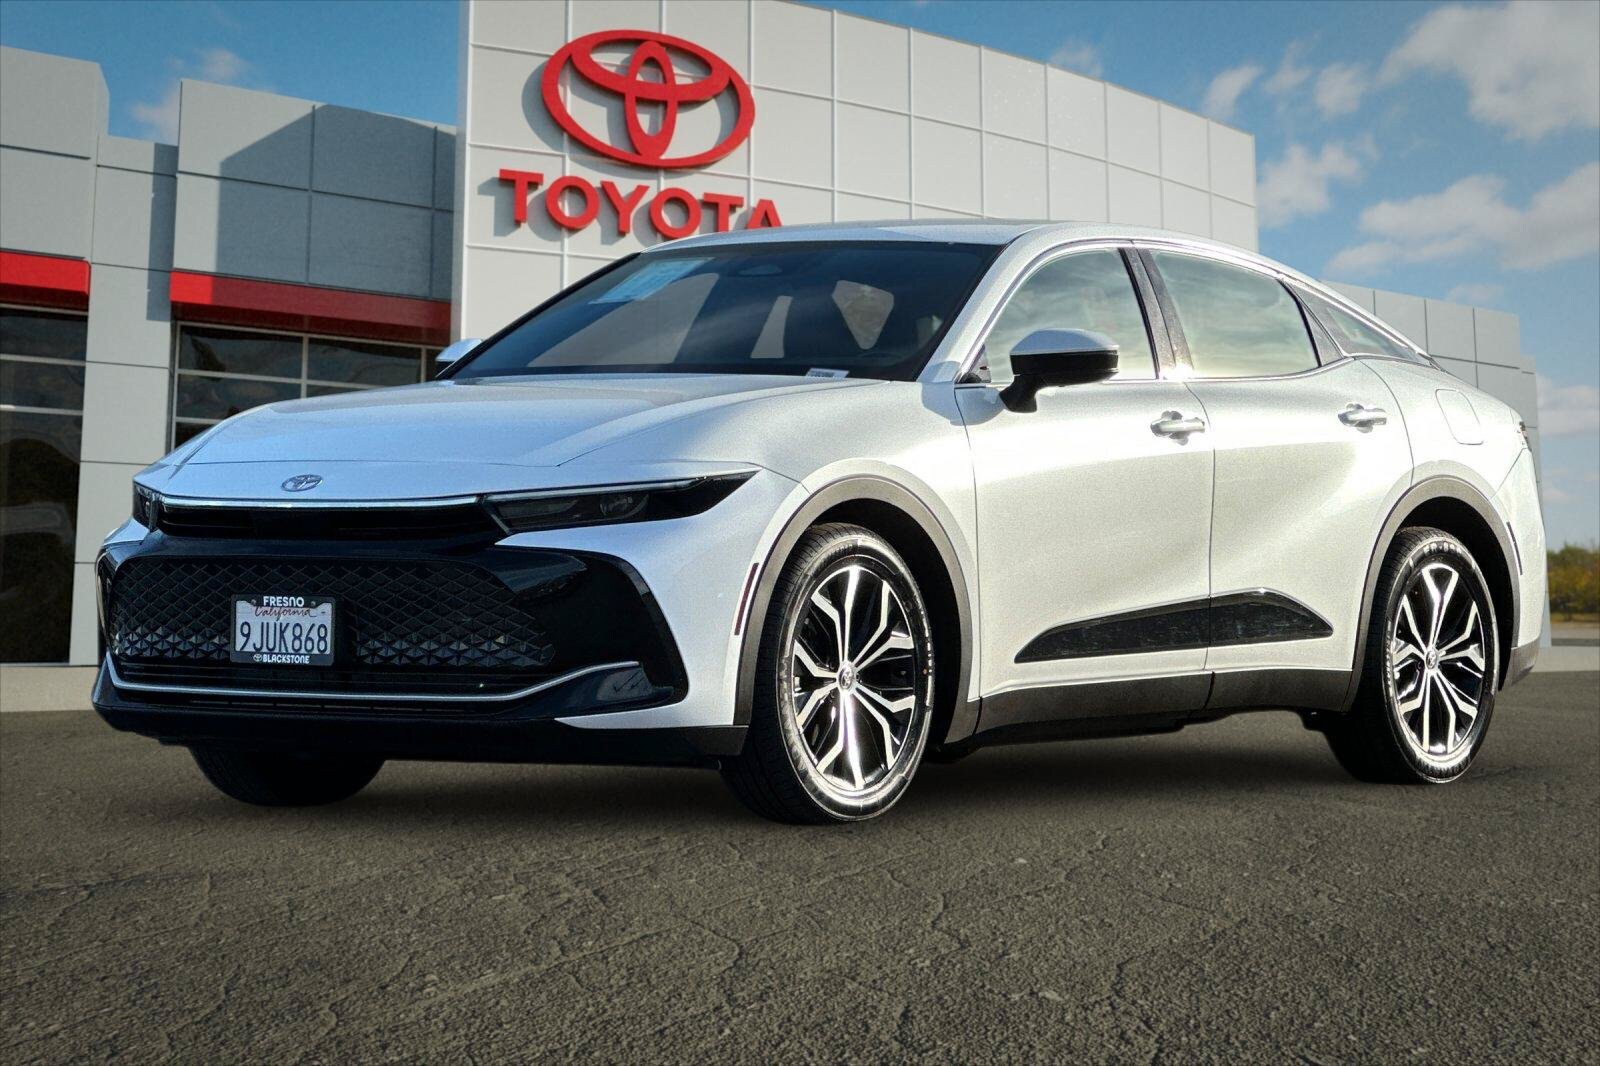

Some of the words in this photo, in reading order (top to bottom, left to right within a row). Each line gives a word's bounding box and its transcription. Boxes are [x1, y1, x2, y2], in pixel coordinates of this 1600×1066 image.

[499, 169, 782, 240] TOYOTA
[263, 595, 305, 607] FRESNO
[254, 606, 317, 622] California
[240, 621, 328, 654] 9JUK868
[262, 653, 310, 664] BLACKSTONE
